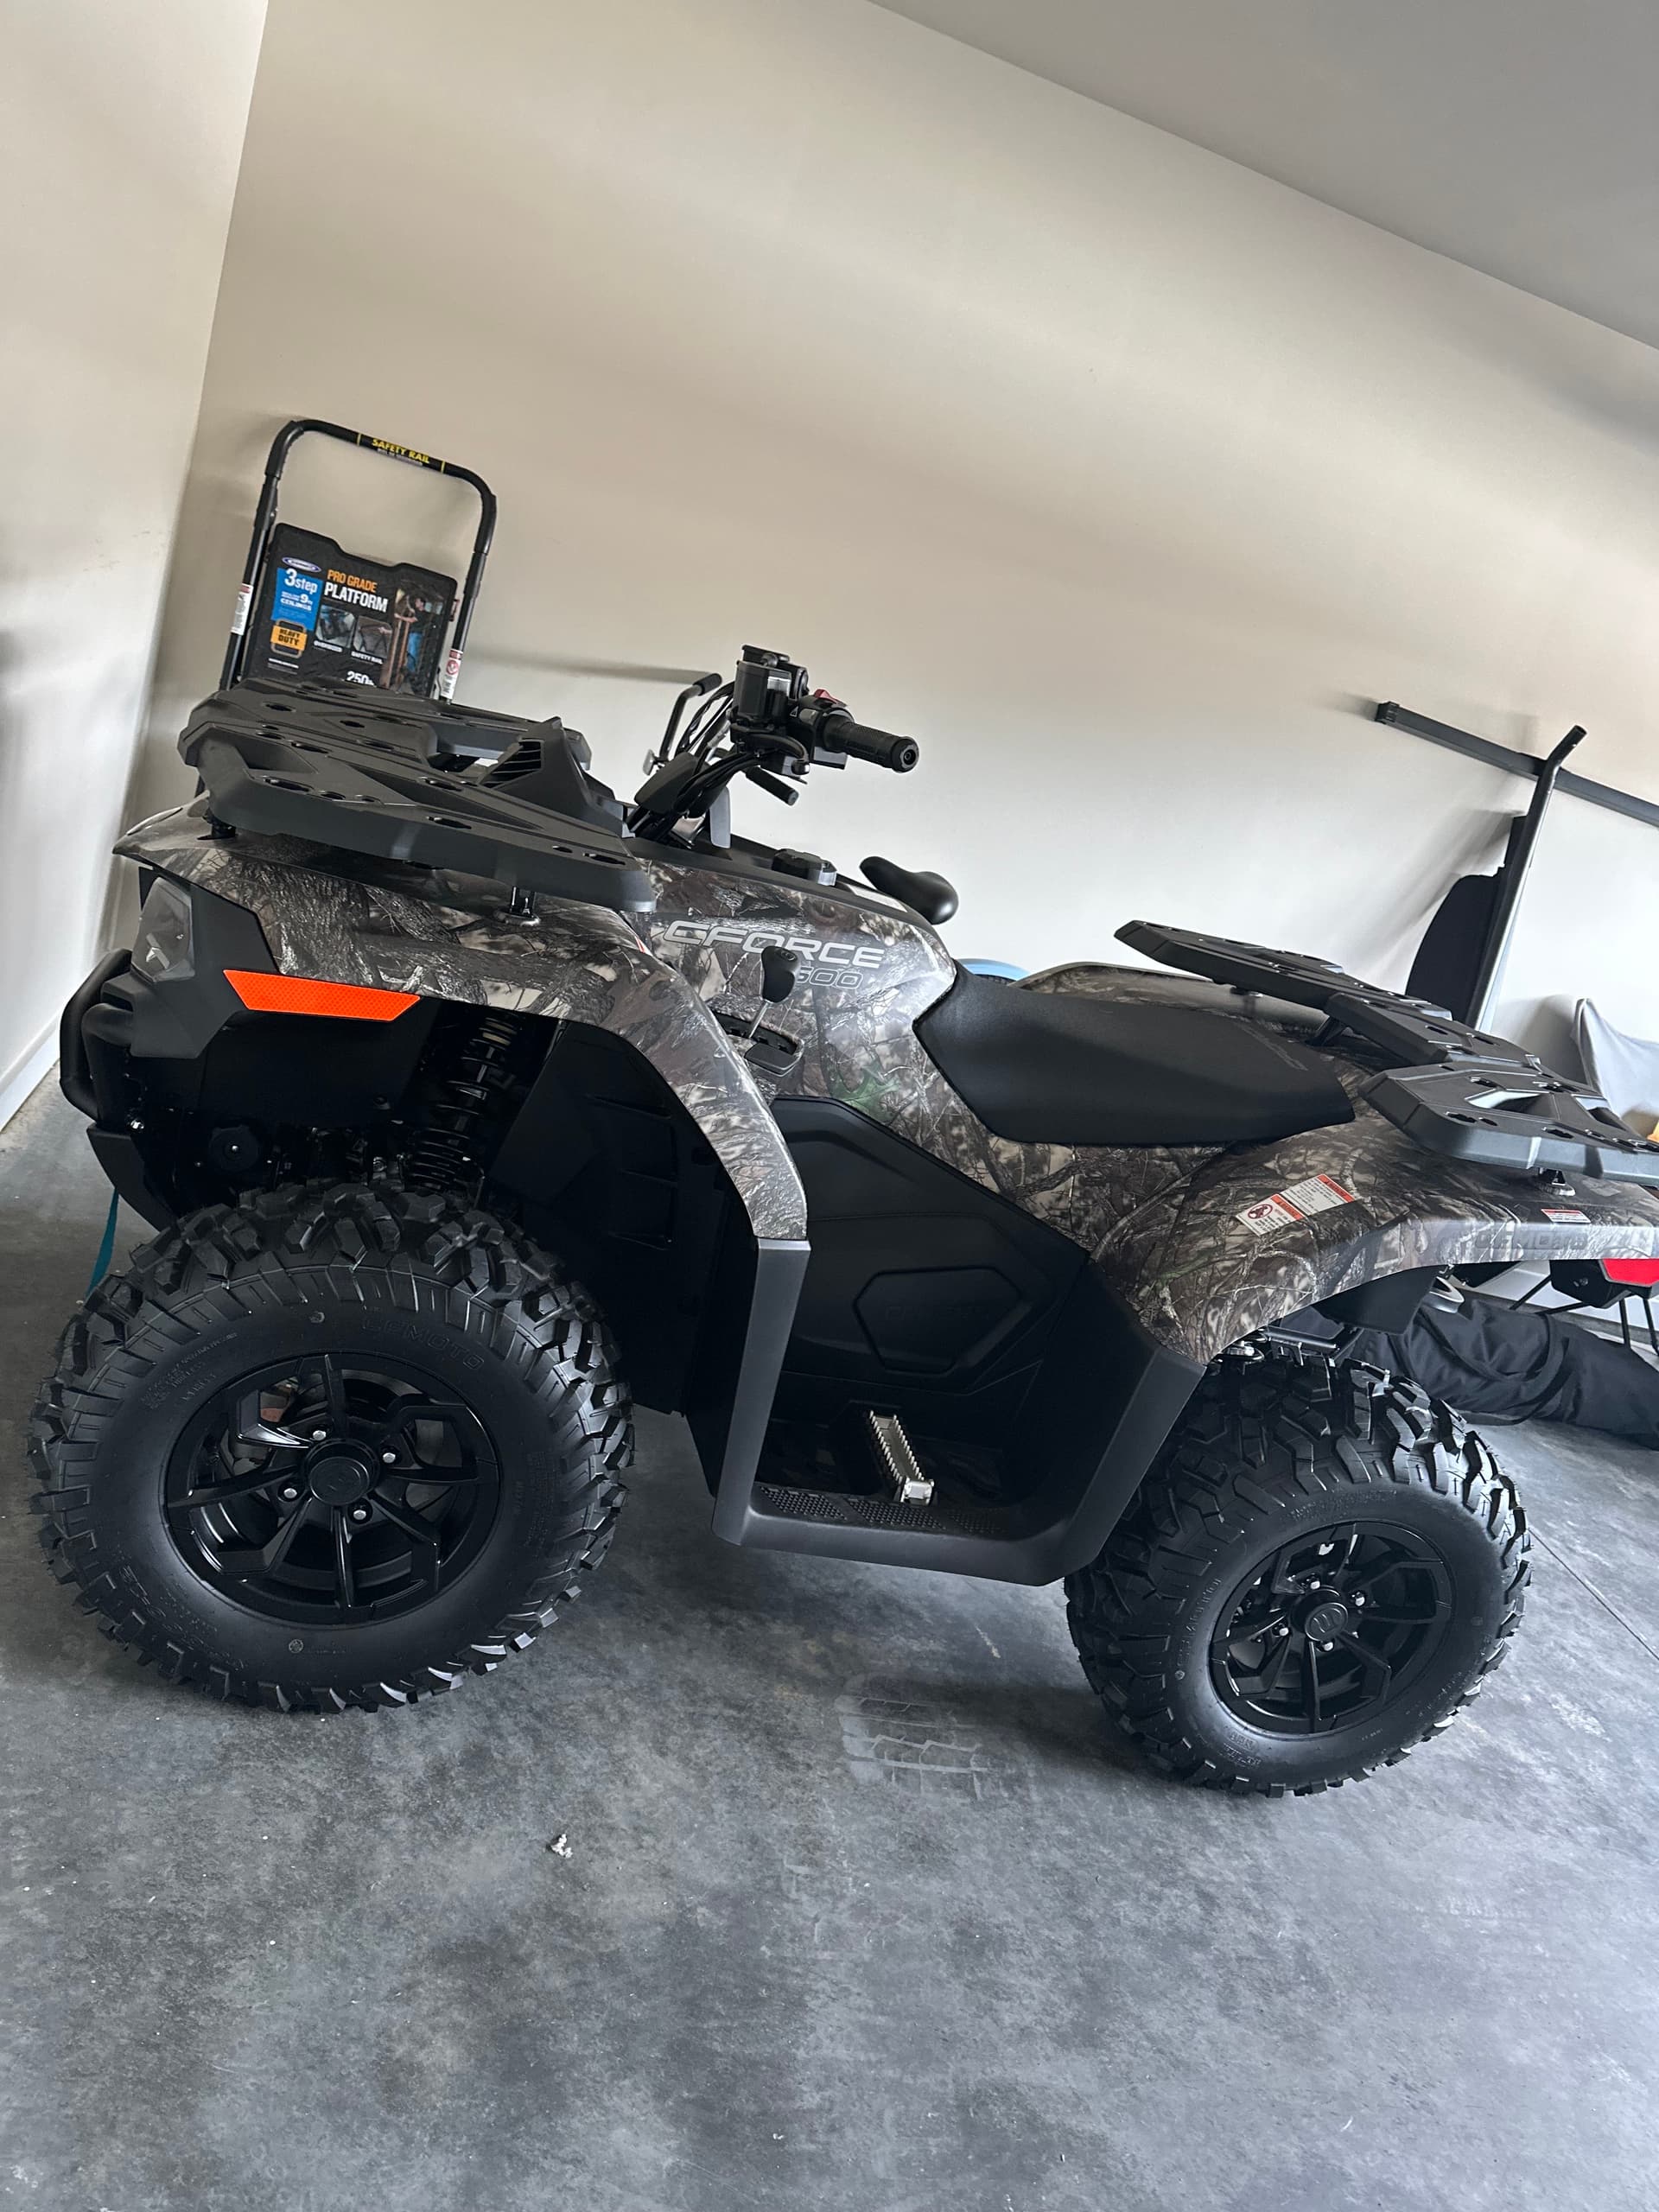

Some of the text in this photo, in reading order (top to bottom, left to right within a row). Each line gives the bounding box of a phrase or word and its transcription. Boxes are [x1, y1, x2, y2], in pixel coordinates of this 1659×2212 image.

[372, 438, 407, 455] SAFETY
[408, 450, 430, 464] RAIL
[327, 569, 378, 593] PRO GRADE
[324, 582, 389, 613] PLATFORM
[277, 634, 300, 645] DUTY
[279, 627, 301, 639] HEAVY
[663, 920, 885, 969] CFORCE
